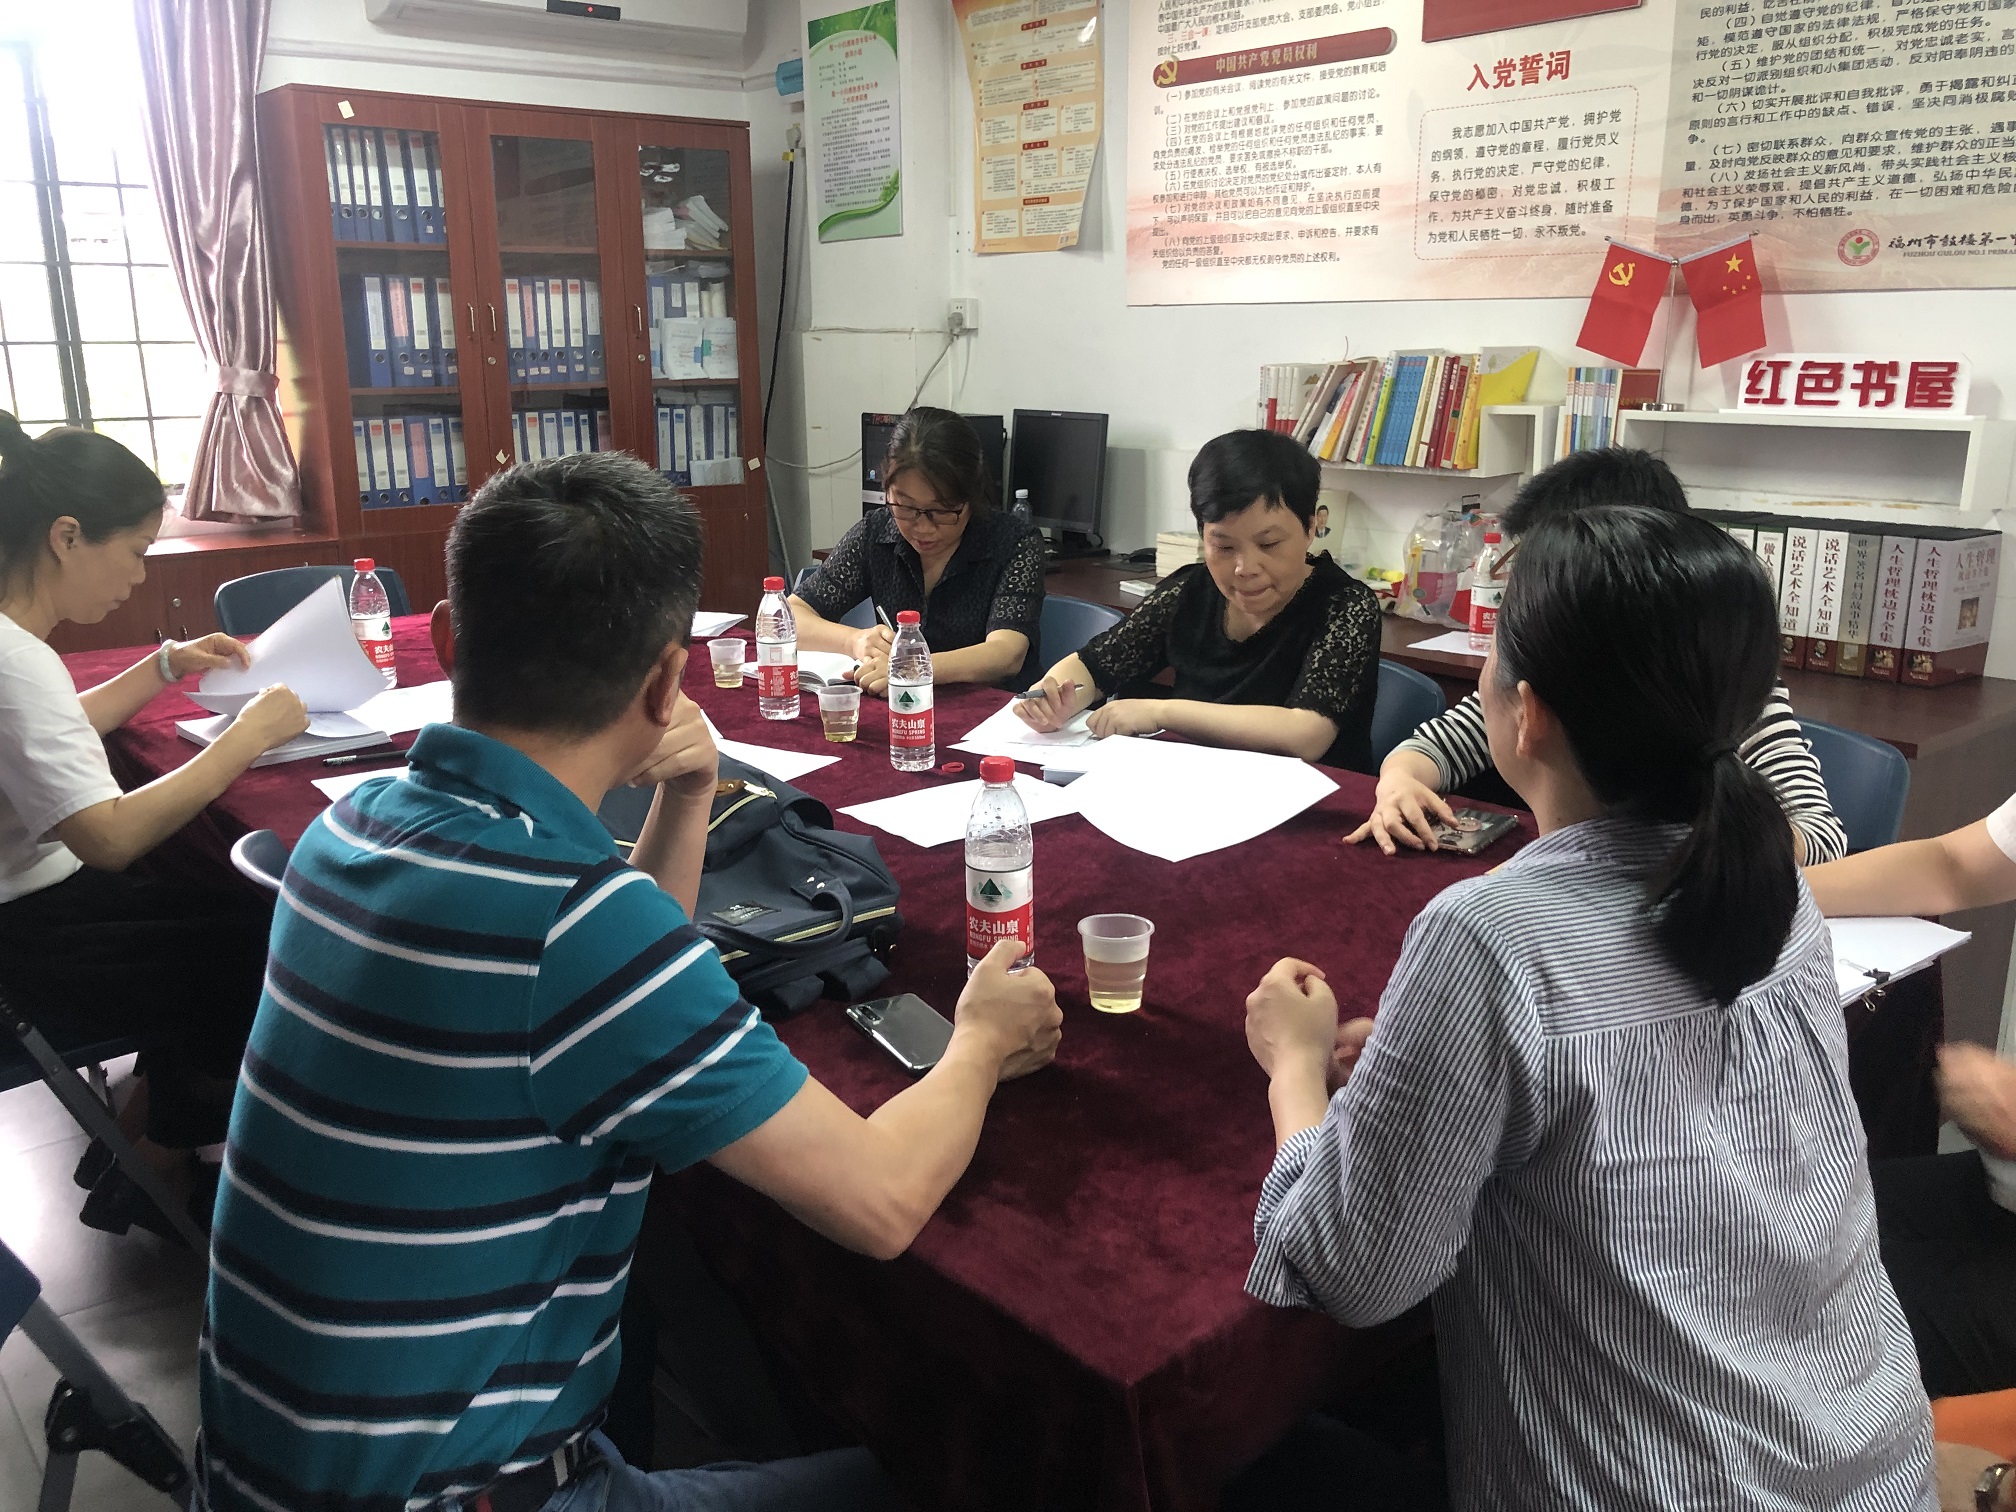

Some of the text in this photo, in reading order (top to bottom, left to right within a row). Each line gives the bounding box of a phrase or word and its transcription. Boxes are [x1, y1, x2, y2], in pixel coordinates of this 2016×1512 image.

[1215, 42, 1318, 73] 中国共产党党员权利
[1466, 50, 1571, 91] 入党誓词
[1691, 85, 1787, 103] 和一切阴谋诡计。
[1686, 133, 1706, 145] 争。
[1679, 207, 1853, 225] 身而出，英勇斗争，不怕牺牲。
[1903, 250, 1935, 258] FUZHOU
[1937, 249, 1966, 257] GULOU
[1743, 360, 1960, 409] 红色书屋
[1782, 535, 1807, 631] 说话艺术全知道
[1815, 538, 1841, 635] 说话艺术全知道
[1879, 543, 1905, 643] 人生哲理枕边书全集
[1917, 546, 1942, 647] 人生哲理枕边书全集
[892, 717, 926, 729] 农夫山泉
[969, 916, 1019, 934] 农夫山泉
[970, 931, 991, 943] NONGFU
